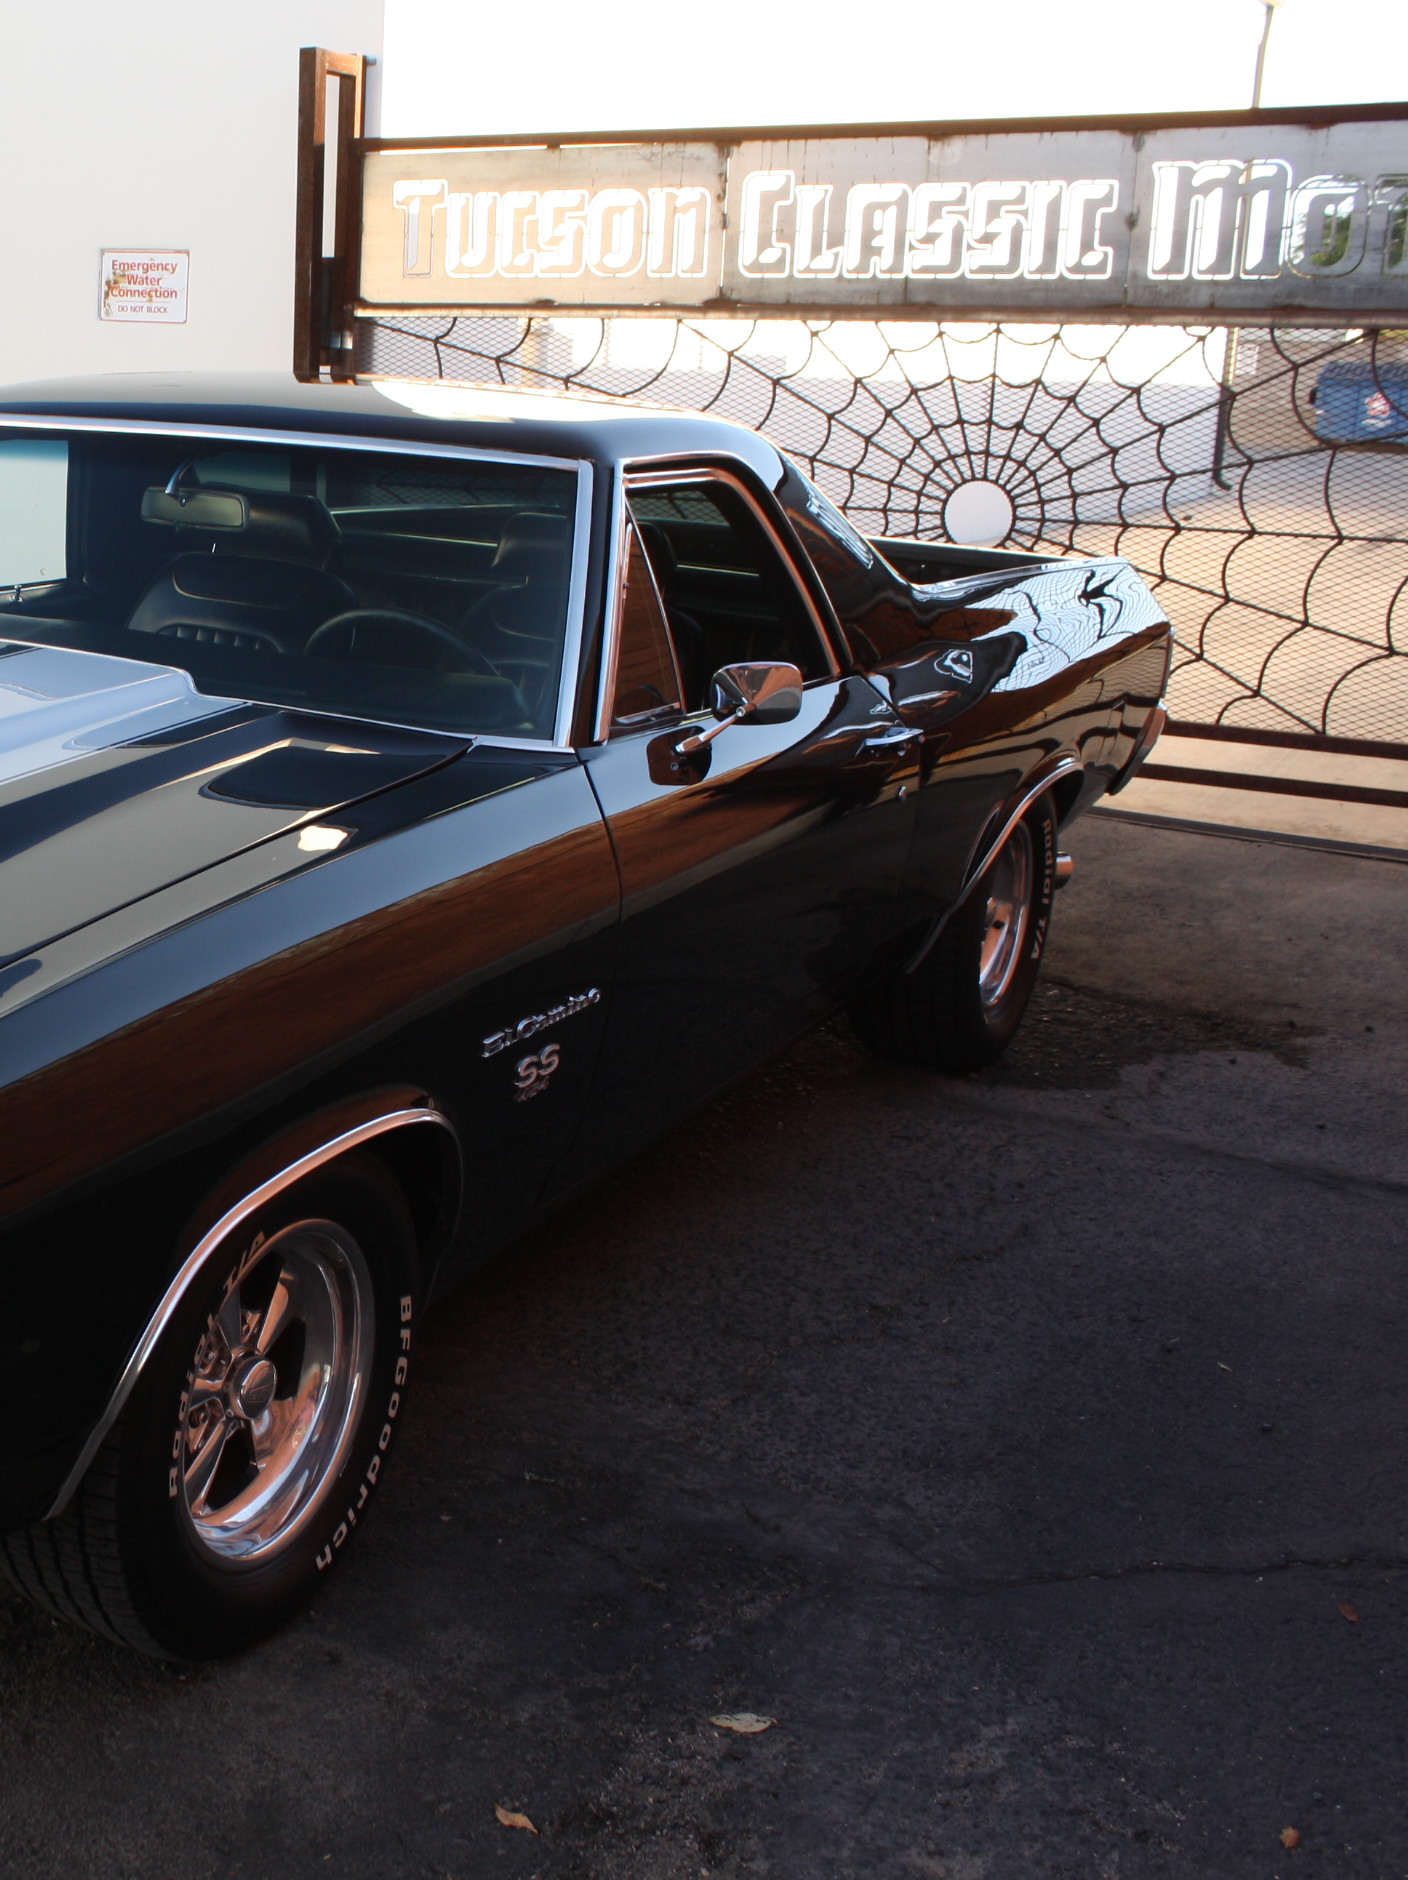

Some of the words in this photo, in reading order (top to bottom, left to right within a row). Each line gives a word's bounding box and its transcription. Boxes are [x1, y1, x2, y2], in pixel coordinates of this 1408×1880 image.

[111, 259, 178, 275] Emergency
[126, 274, 162, 286] Water
[110, 286, 178, 299] Connection
[117, 305, 128, 313] DO
[130, 305, 144, 313] NOT
[146, 306, 169, 314] BLOCK
[513, 1043, 561, 1088] SS
[315, 1295, 413, 1571] BFGoodrich
